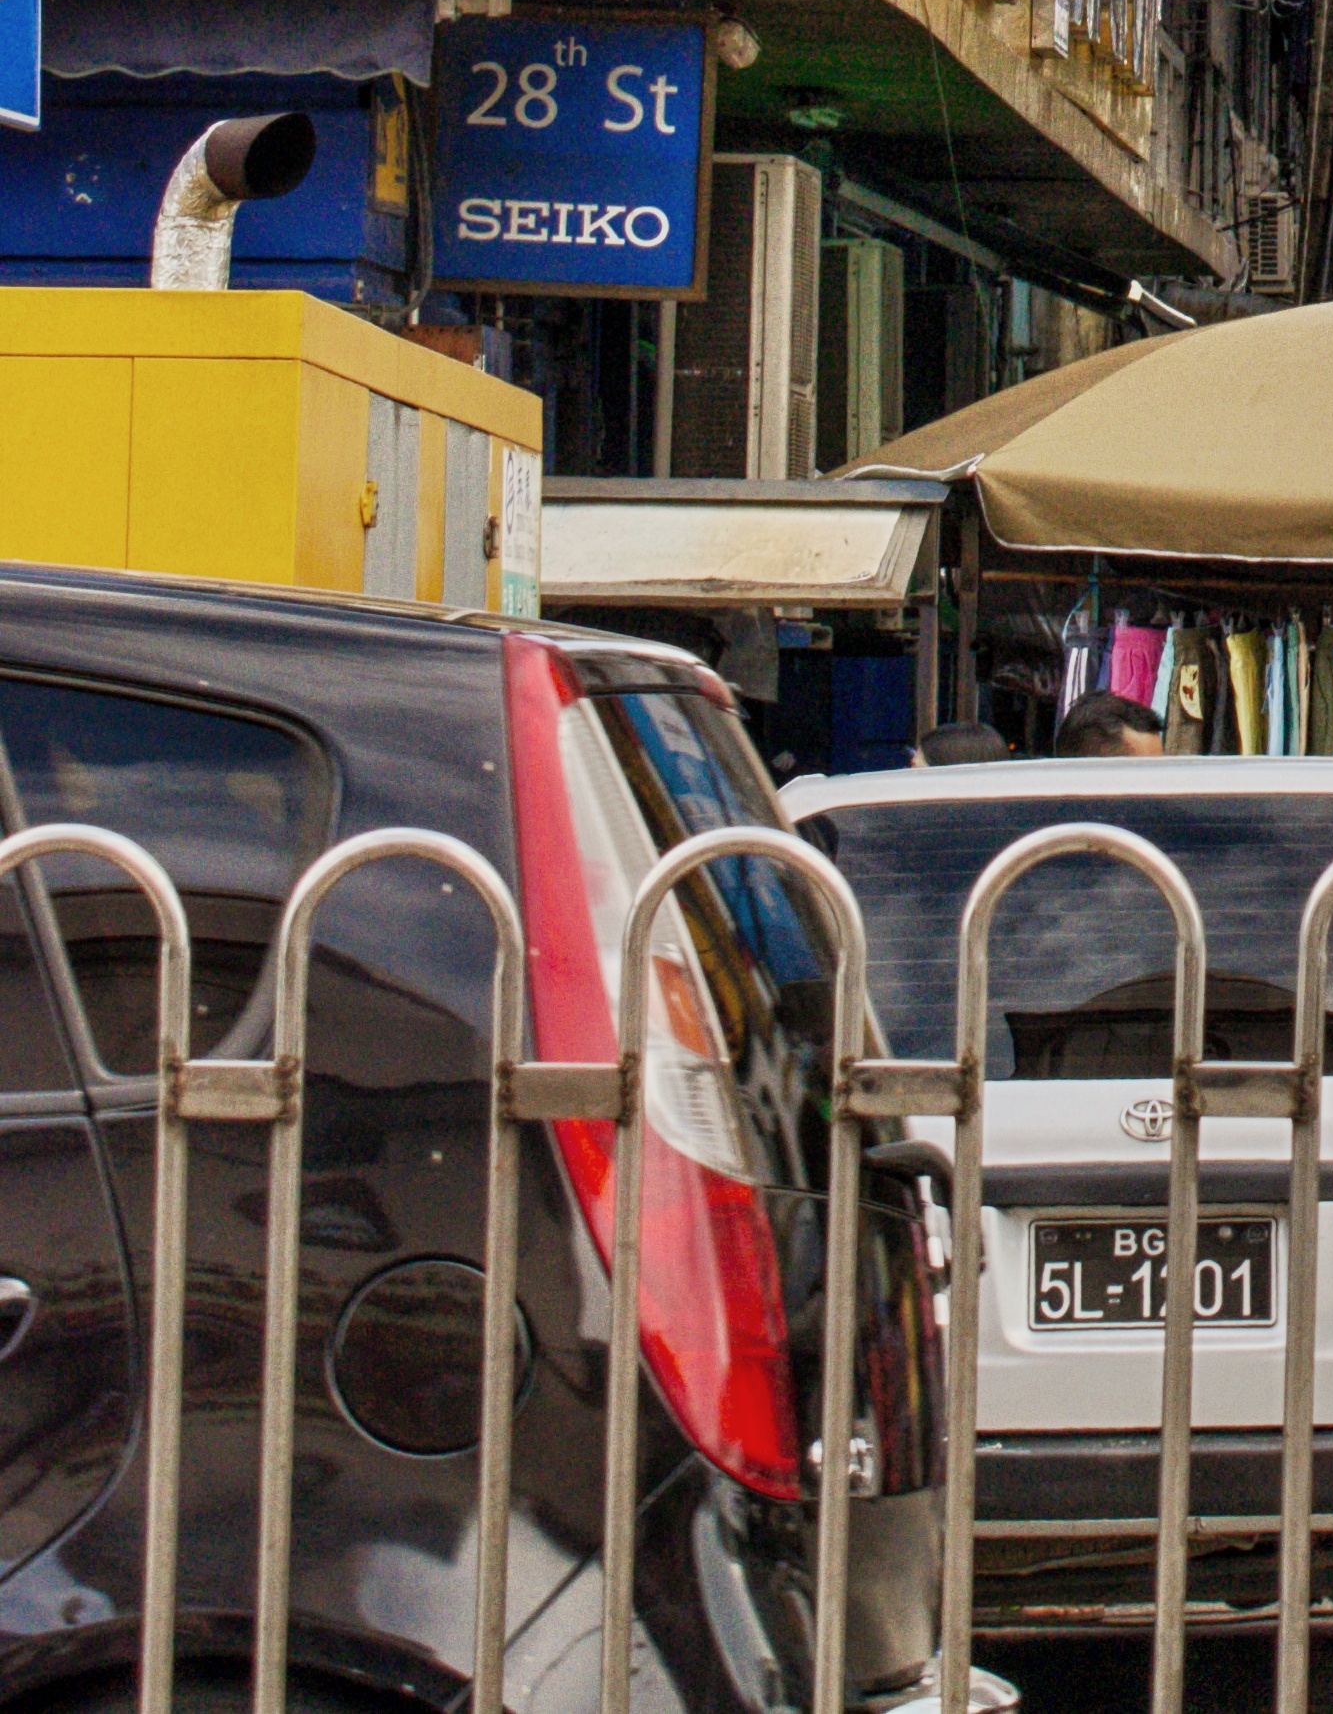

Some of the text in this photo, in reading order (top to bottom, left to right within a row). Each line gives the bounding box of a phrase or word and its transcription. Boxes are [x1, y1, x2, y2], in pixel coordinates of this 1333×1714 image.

[604, 65, 678, 134] St
[458, 198, 670, 248] SEIKO
[1114, 1228, 1168, 1257] BG
[1039, 1258, 1252, 1320] 5L-101
